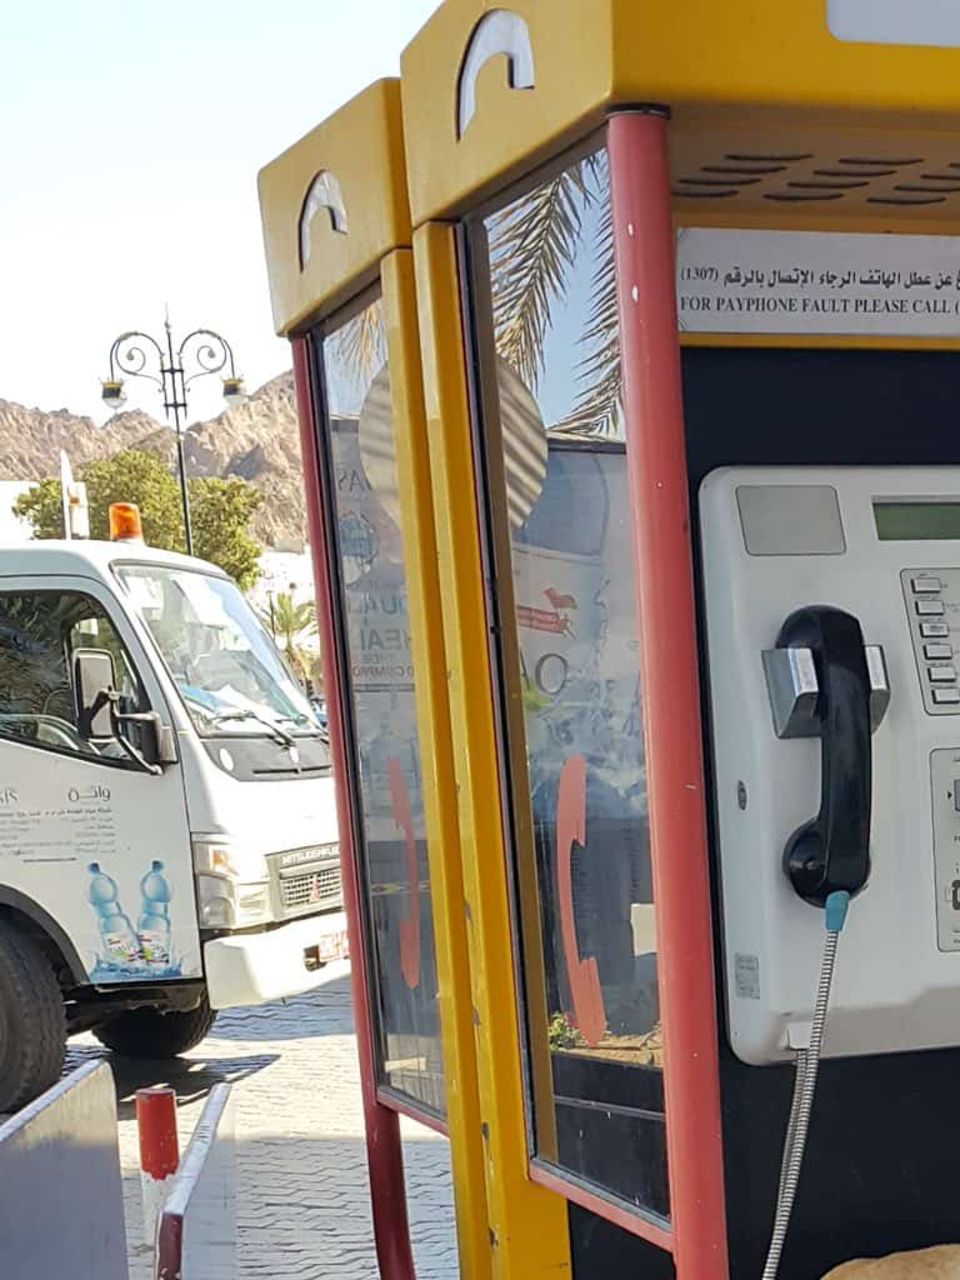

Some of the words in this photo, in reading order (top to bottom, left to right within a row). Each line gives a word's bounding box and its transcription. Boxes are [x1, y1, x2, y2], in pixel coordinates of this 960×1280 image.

[680, 266, 719, 282] (1307)
[723, 265, 766, 288] بالرقم
[818, 269, 857, 289] الرجاء
[859, 269, 901, 290] الهاتف
[903, 270, 932, 290] عطل
[934, 272, 953, 290] عن
[680, 297, 711, 311] FOR
[716, 297, 798, 312] PAYPHONE
[802, 298, 851, 313] FAULT
[855, 299, 909, 313] PLEASE
[912, 300, 951, 314] CALL
